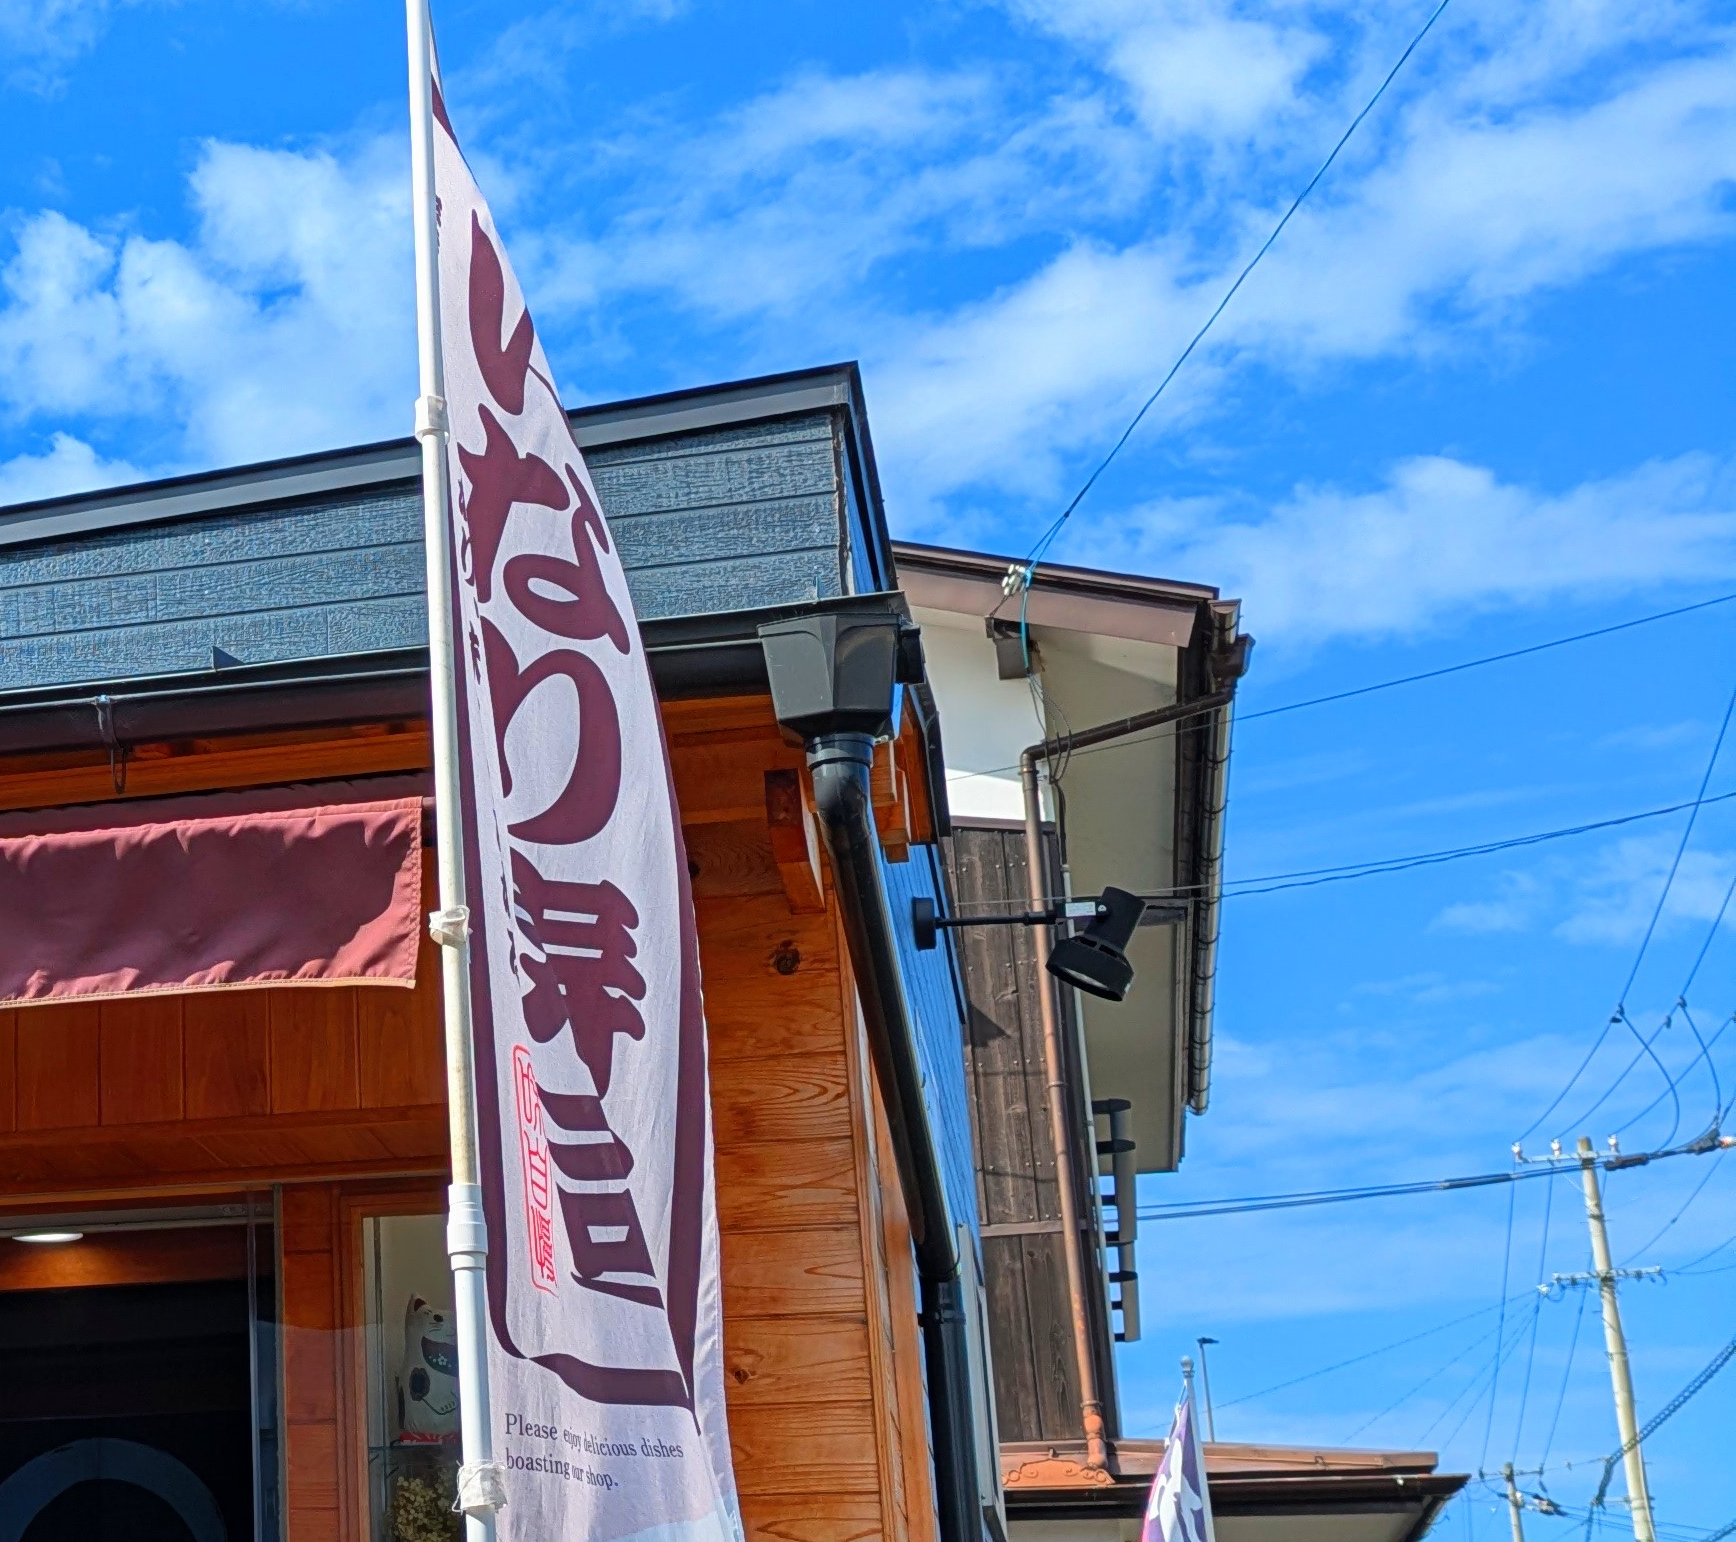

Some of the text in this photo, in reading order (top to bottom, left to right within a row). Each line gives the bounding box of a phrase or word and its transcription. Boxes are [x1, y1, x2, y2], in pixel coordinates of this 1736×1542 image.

[505, 1413, 684, 1458] Please enjoy delicious dishes
[505, 1447, 570, 1478] boasting
[586, 1468, 619, 1491] shop.
